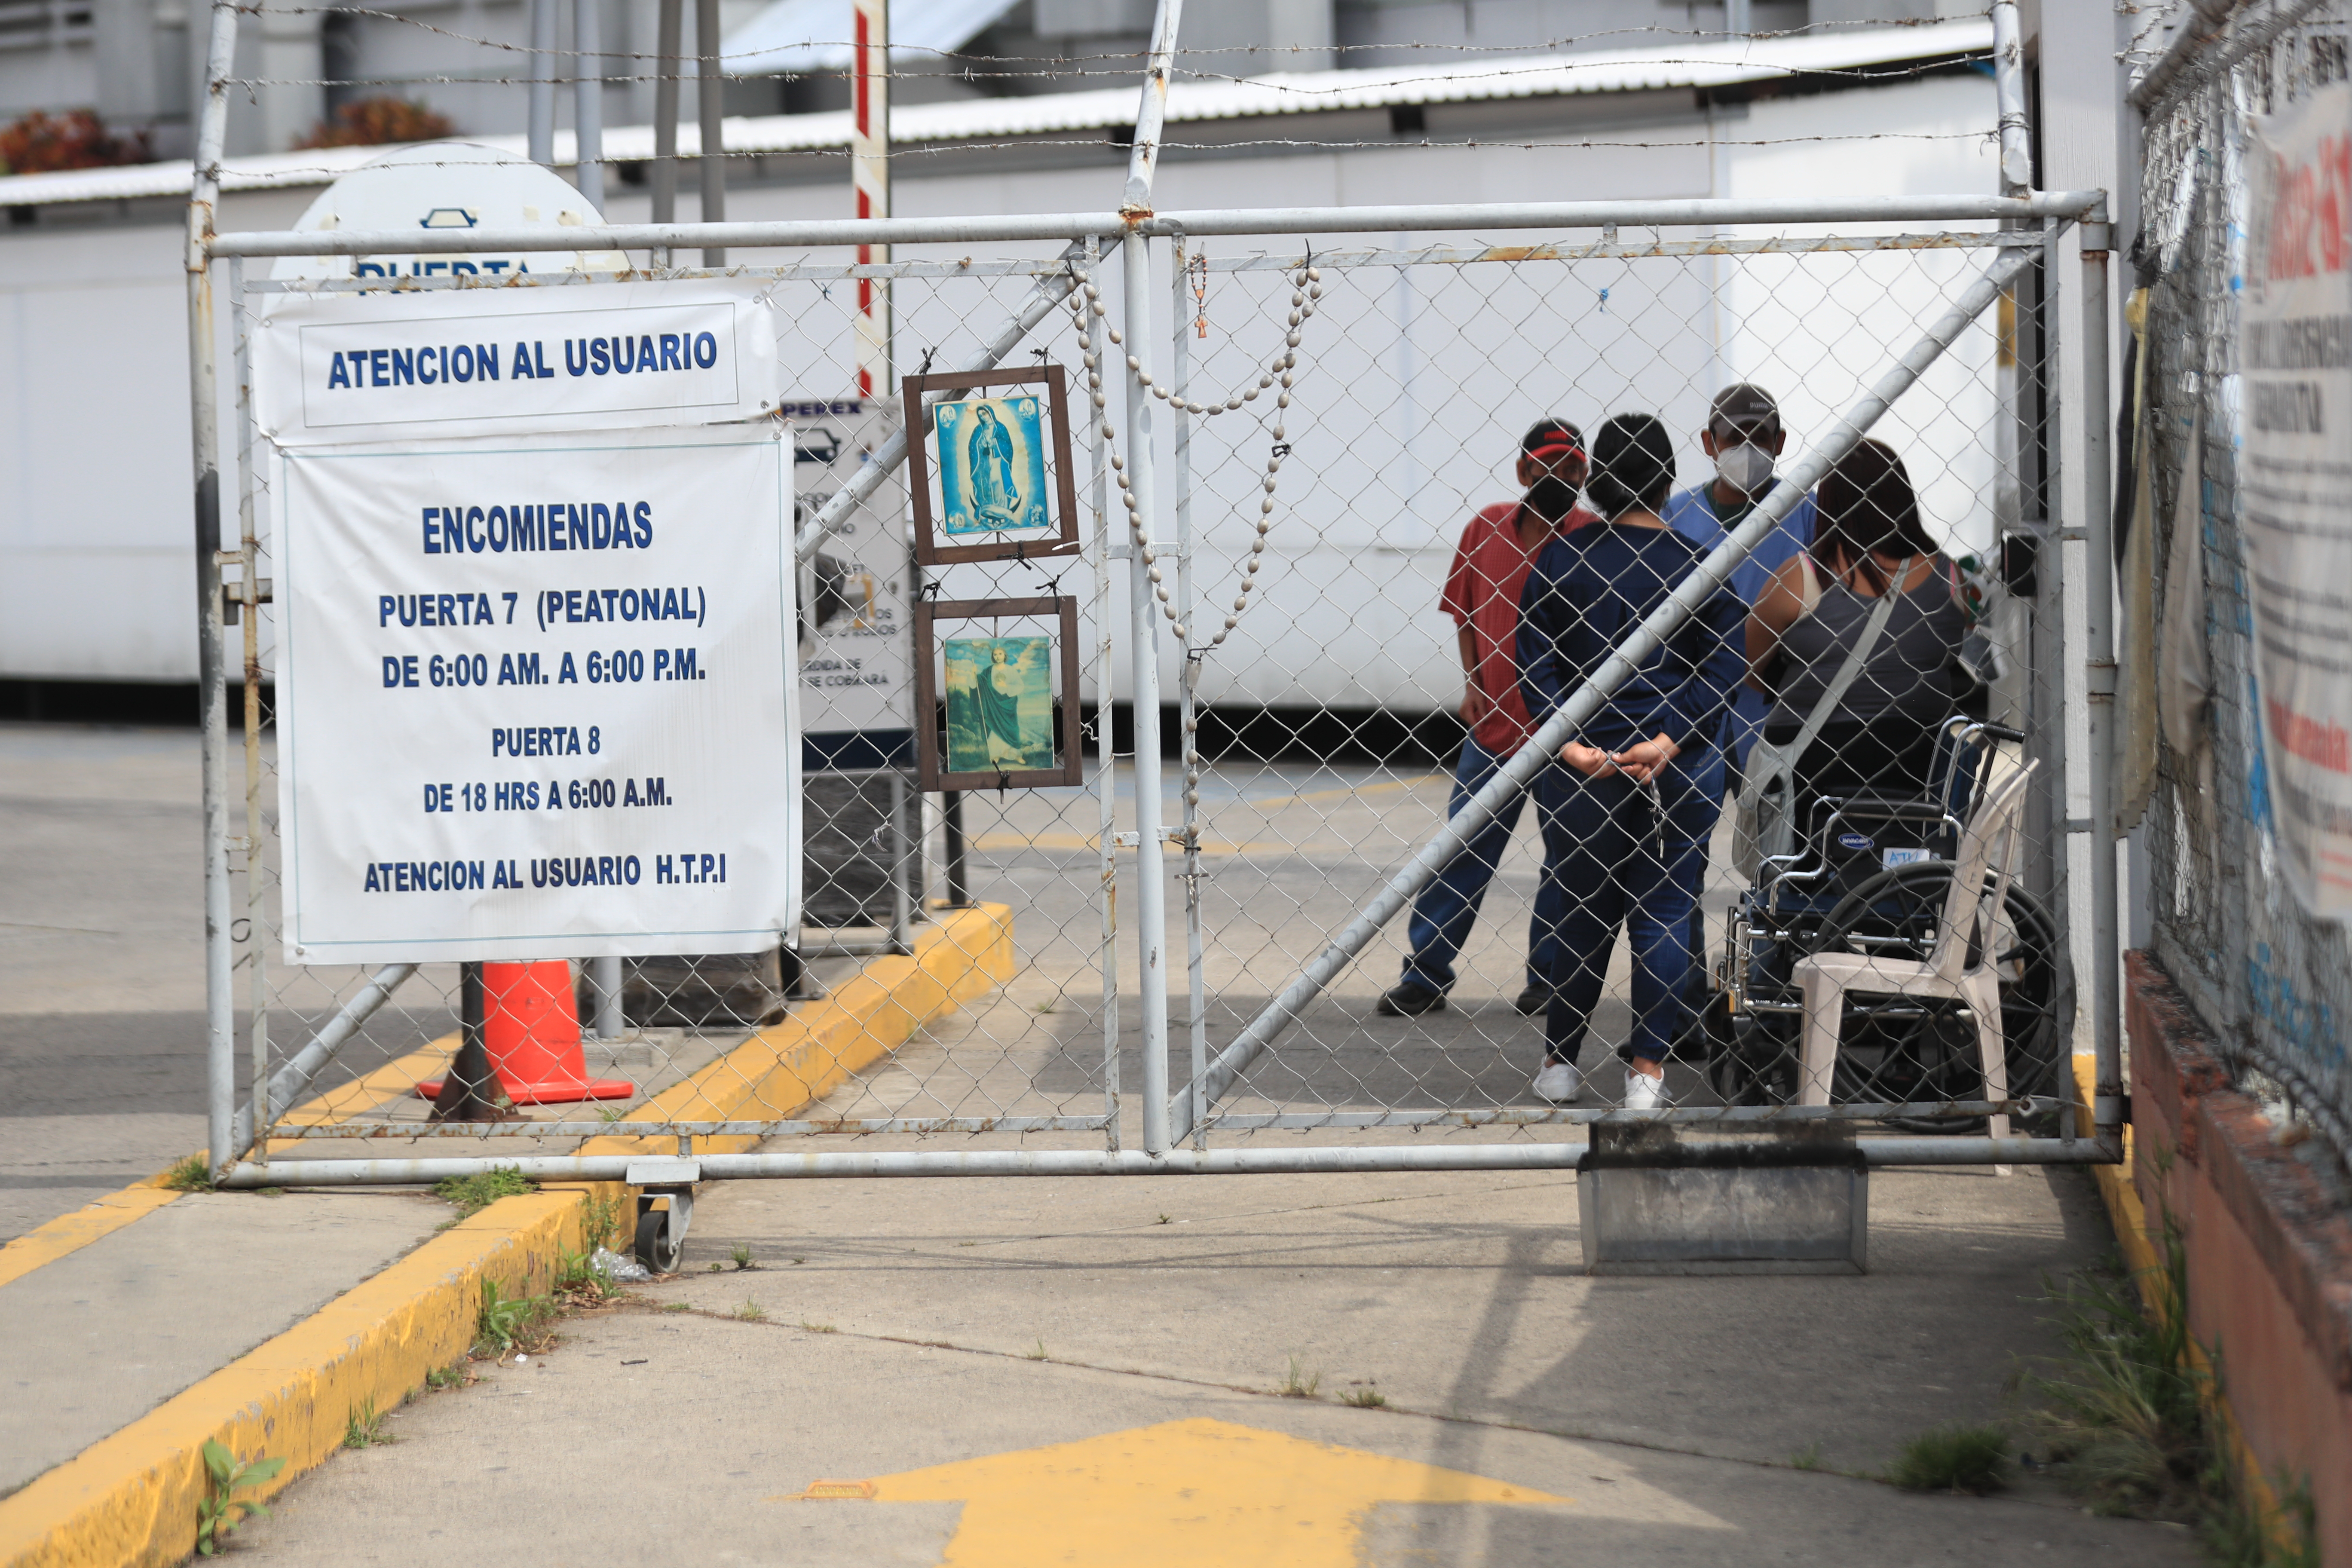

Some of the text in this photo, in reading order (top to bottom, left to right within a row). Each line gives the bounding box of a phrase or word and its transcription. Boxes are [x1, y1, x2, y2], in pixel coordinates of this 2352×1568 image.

[328, 331, 717, 390] ATENCION AL USUARIO
[422, 501, 653, 554] ENCOMIENDAS
[379, 586, 706, 633] PUERTA 7 (PEATONAL)
[382, 647, 706, 688] DE 6:00 AM. A 6:00 P.M.
[492, 725, 600, 757] PUERTA 8
[424, 777, 672, 813] DE 18 HRS A 6:00 A.M.
[364, 853, 726, 893] ATENCION AL USUARIO H.T.P.I
